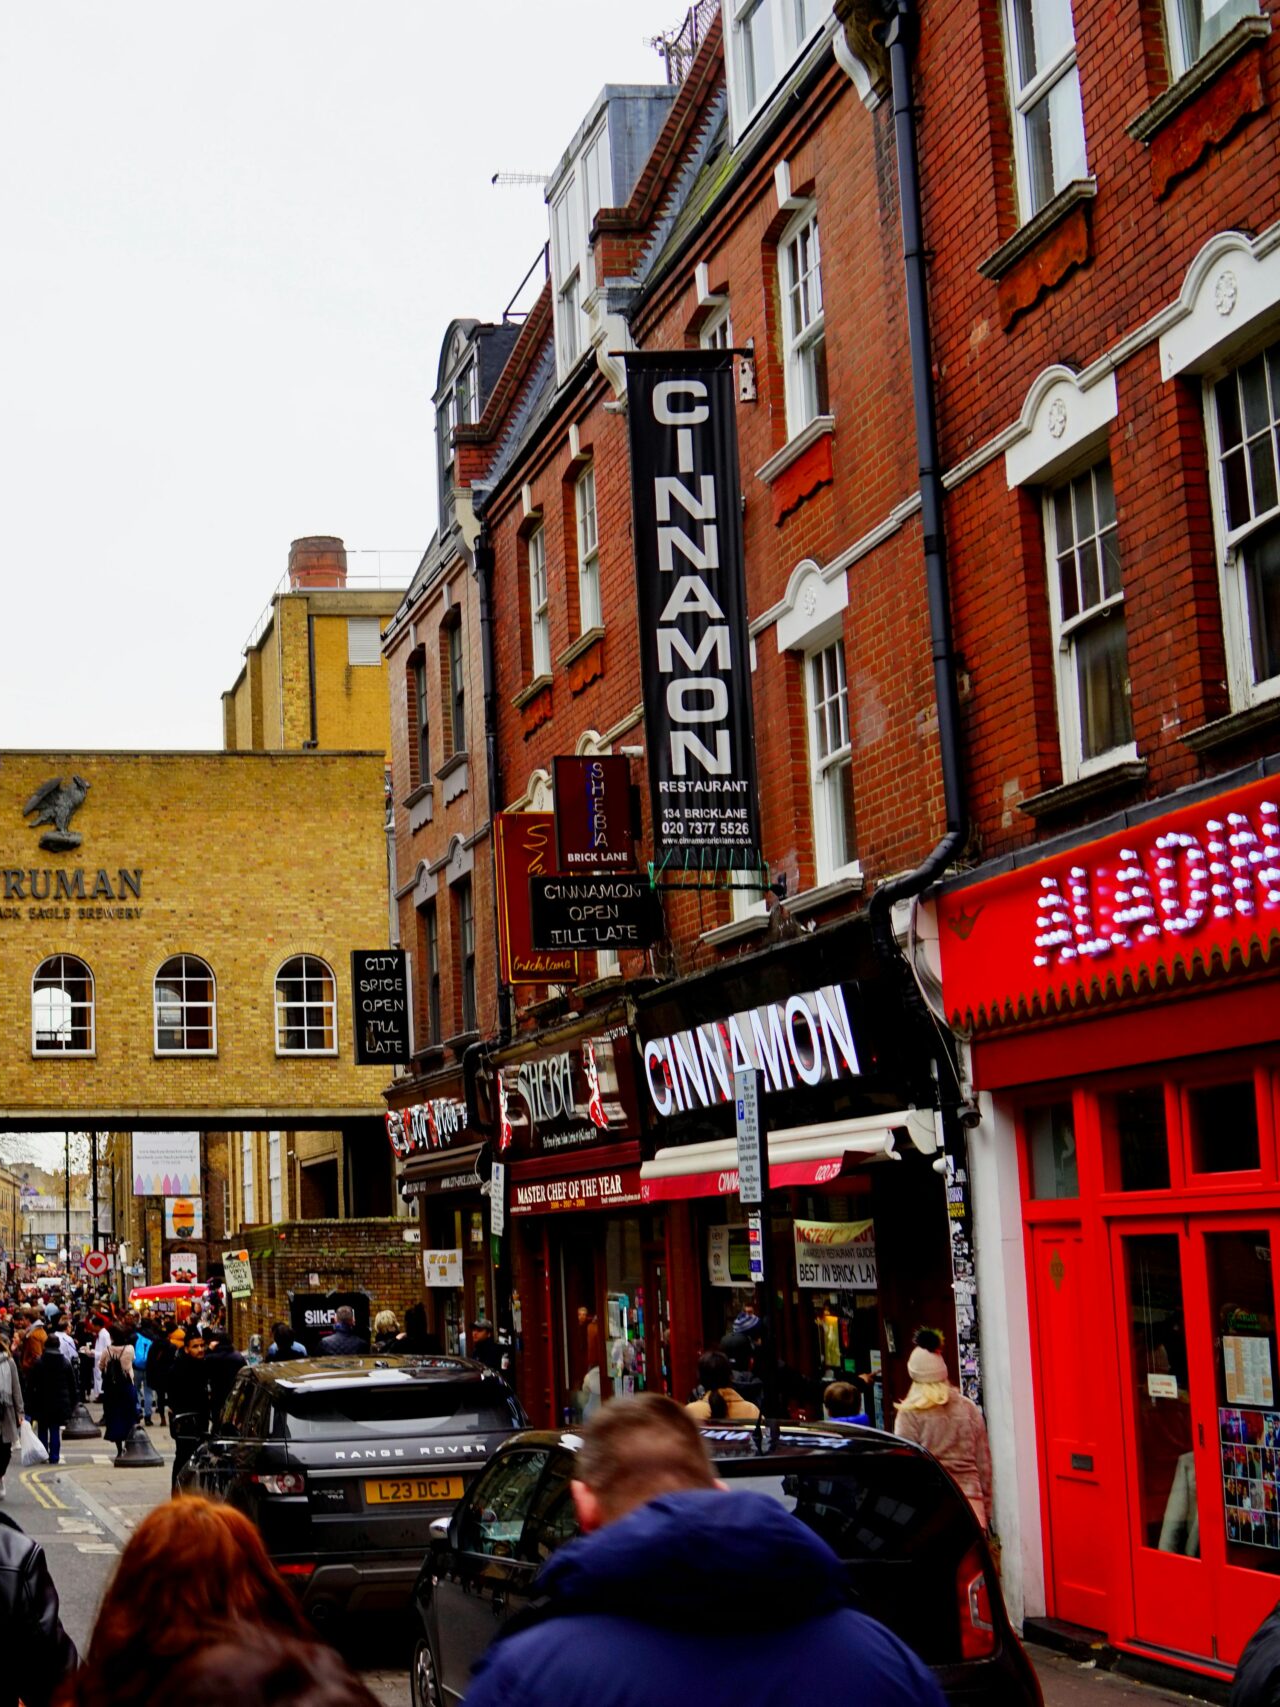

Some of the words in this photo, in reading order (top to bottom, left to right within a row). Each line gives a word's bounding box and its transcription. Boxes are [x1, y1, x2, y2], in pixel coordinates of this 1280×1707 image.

[652, 380, 732, 776] CINNAMON
[659, 781, 748, 793] RESTAURANT
[591, 762, 609, 847] SHEBA
[663, 808, 681, 819] 134
[685, 808, 748, 819] BRICKLANE
[661, 822, 684, 835] 020
[688, 822, 716, 835] 7377
[720, 822, 749, 835] 5526
[567, 853, 599, 863] BRICK
[601, 852, 628, 862] LANE
[544, 883, 642, 900] CINNAMON
[1033, 800, 1280, 967] ALADIN
[28, 907, 71, 920] EAGLE
[78, 907, 144, 920] BREWERY
[569, 904, 619, 921] OPEN
[594, 925, 639, 941] LATE
[365, 957, 399, 971] CITY
[360, 978, 403, 993] SPICE
[362, 999, 404, 1013] OPEN
[365, 1040, 403, 1054] LATE
[645, 984, 861, 1117] CINNAMON
[517, 1052, 576, 1148] SHEBA
[517, 1185, 547, 1205] MASTER
[547, 1181, 567, 1201] CHEF
[568, 1180, 580, 1199] OF
[581, 1177, 598, 1198] THE
[598, 1174, 623, 1196] YEAR
[718, 1172, 740, 1192] CINNA
[799, 1263, 820, 1282] BEST
[822, 1264, 831, 1282] IN
[833, 1264, 858, 1283] BRICK
[304, 1309, 344, 1325] SilkF
[335, 1449, 405, 1460] RANGE
[420, 1444, 487, 1456] ROVER
[378, 1481, 413, 1501] L23
[418, 1479, 451, 1499] DCJ
